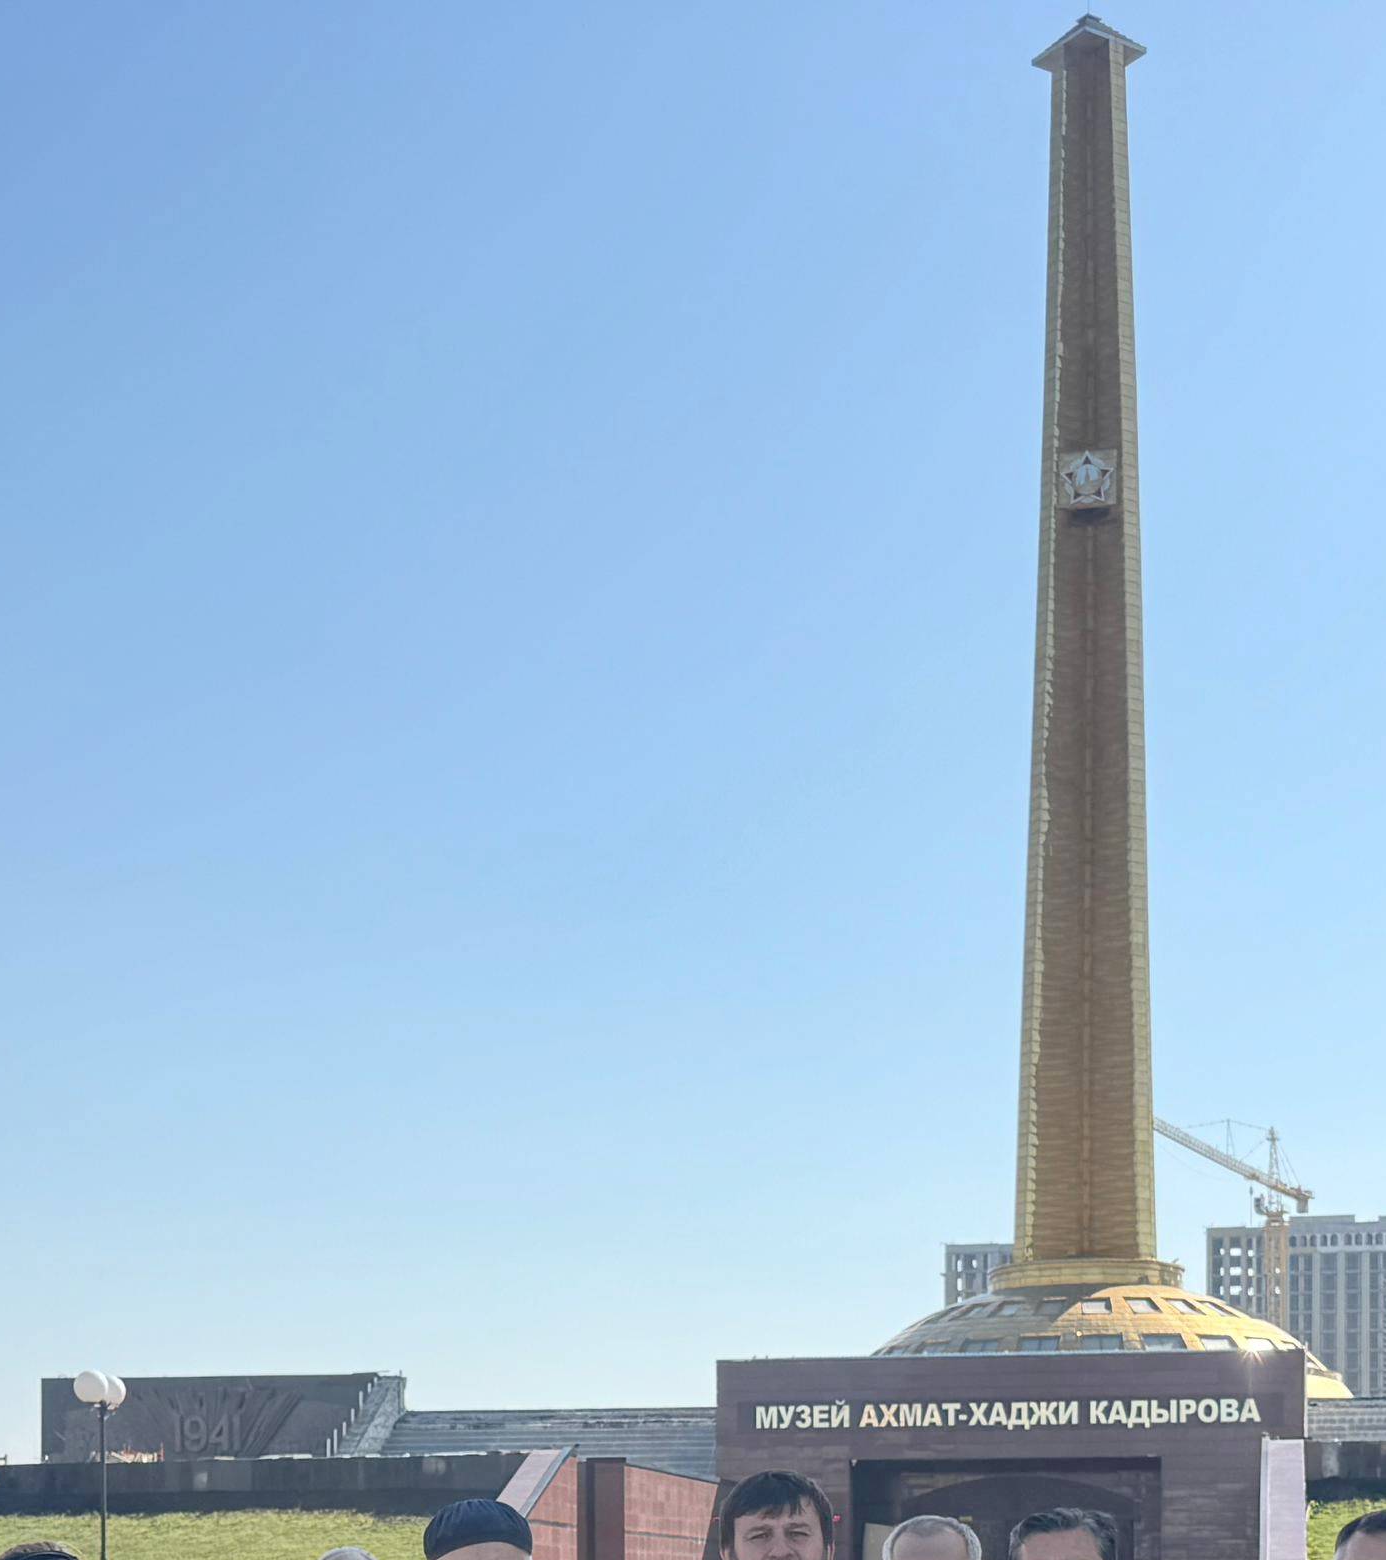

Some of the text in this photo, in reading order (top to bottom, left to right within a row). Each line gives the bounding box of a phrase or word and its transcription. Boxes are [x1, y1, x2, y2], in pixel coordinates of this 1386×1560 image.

[174, 1413, 241, 1452] 1941
[755, 1398, 1262, 1431] МУЗЕЙ АХМАТ-ХАДЖИ КАДЫРОВА
